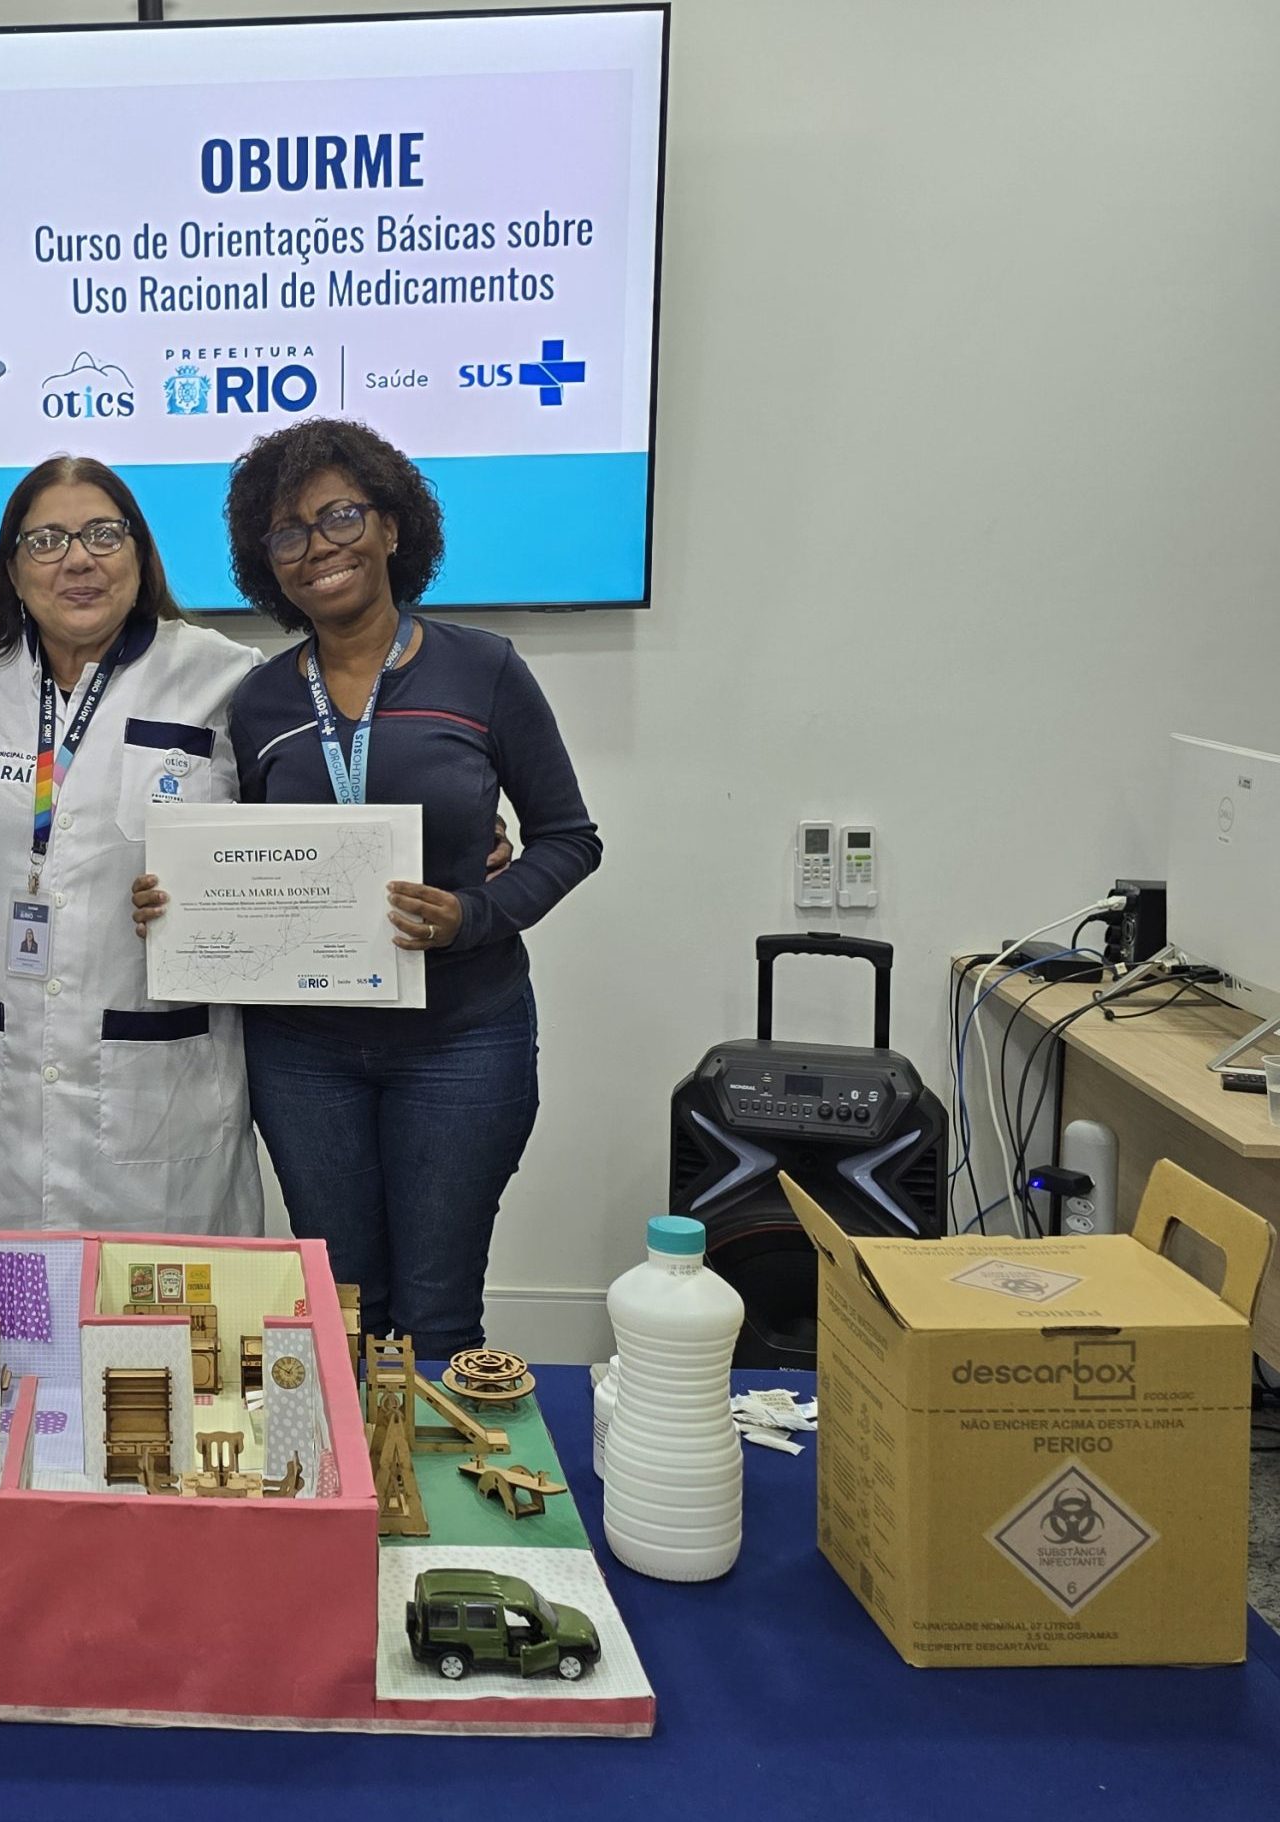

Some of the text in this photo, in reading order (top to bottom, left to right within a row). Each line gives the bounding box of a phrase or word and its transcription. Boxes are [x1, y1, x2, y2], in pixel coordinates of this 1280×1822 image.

[201, 133, 424, 194] OBURME
[35, 210, 594, 266] Curso de Orientações Básicas sobre
[73, 267, 554, 314] Uso Racional de Medicamentos
[165, 346, 315, 360] PREFEITURA
[365, 368, 429, 389] Saúde
[458, 363, 513, 388] SUS
[217, 364, 318, 414] RIO
[42, 386, 134, 419] otics
[214, 848, 318, 864] CERTIFICADO
[203, 887, 331, 898] ANGELA MARIA BONFIM
[308, 978, 329, 989] RIO
[952, 1358, 1136, 1384] descarbox
[960, 1418, 1184, 1431] NÃO ENCHER ACIMA DESTA LINHA
[1033, 1437, 1113, 1454] PERIGO
[1037, 1546, 1107, 1557] SUBSTÂNCIA
[1039, 1557, 1105, 1567] INFECTANTE
[1066, 1581, 1077, 1595] 6
[913, 1621, 979, 1632] CAPACIDADE
[981, 1621, 1029, 1631] NOMINAL
[1044, 1621, 1081, 1630] LITROS
[1043, 1631, 1119, 1641] QUILOGRAMAS
[913, 1641, 1050, 1652] RECIPIENTE DESCARTÁVEL
